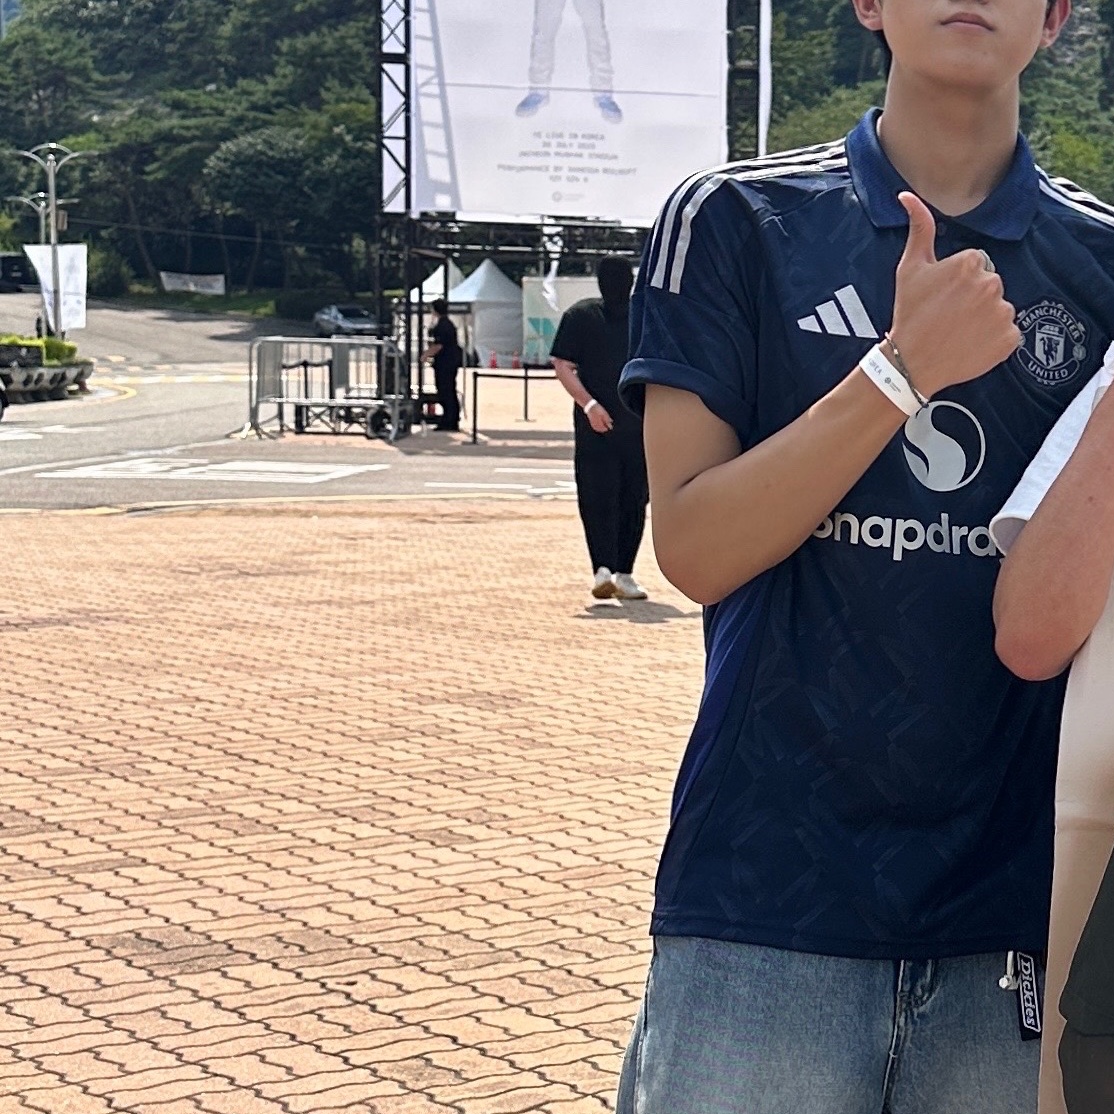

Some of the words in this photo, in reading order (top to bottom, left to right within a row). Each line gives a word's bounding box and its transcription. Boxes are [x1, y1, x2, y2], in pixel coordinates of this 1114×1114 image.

[1022, 306, 1081, 340] MANCHESTER
[1028, 360, 1068, 380] UNITED
[1020, 959, 1036, 1026] Dickies
